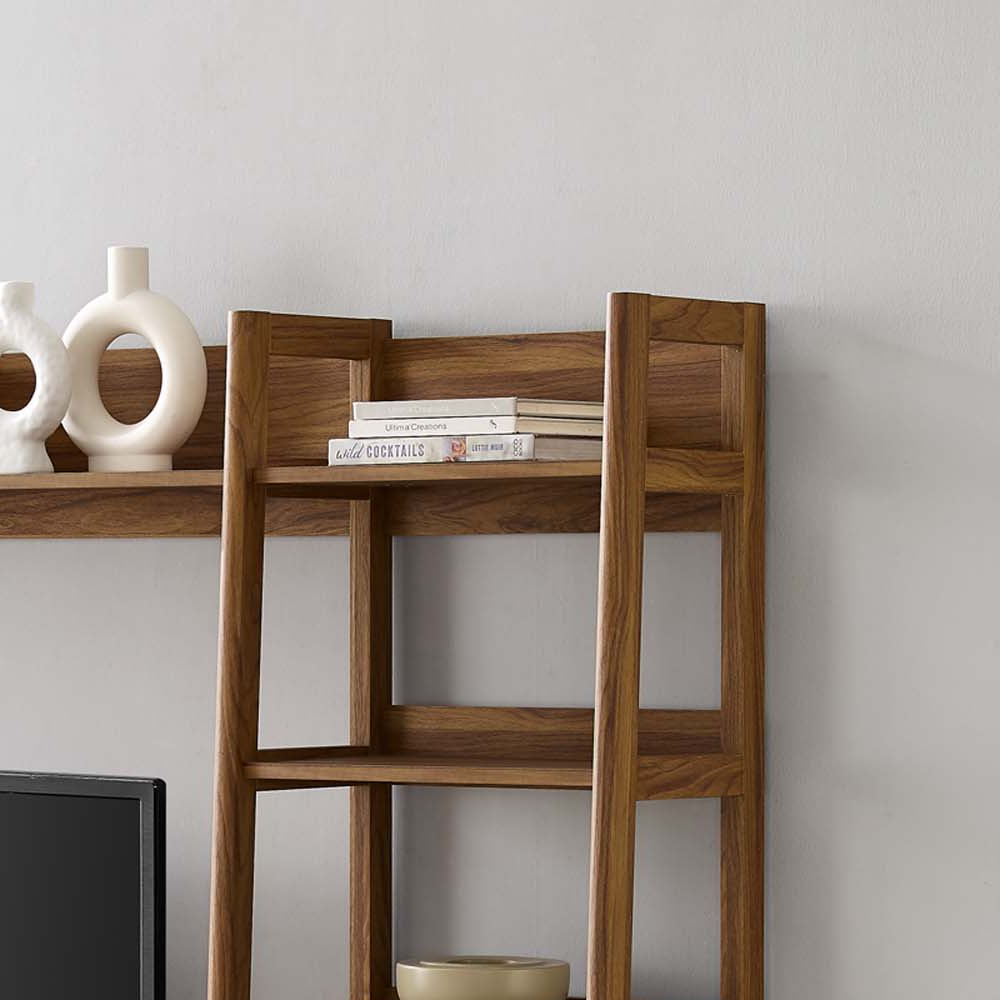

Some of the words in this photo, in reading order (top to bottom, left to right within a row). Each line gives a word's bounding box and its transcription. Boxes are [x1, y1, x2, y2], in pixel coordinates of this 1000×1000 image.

[384, 423, 410, 432] Ultima
[410, 422, 448, 431] Creations
[335, 442, 364, 460] wild
[366, 443, 425, 459] COCKTAILS
